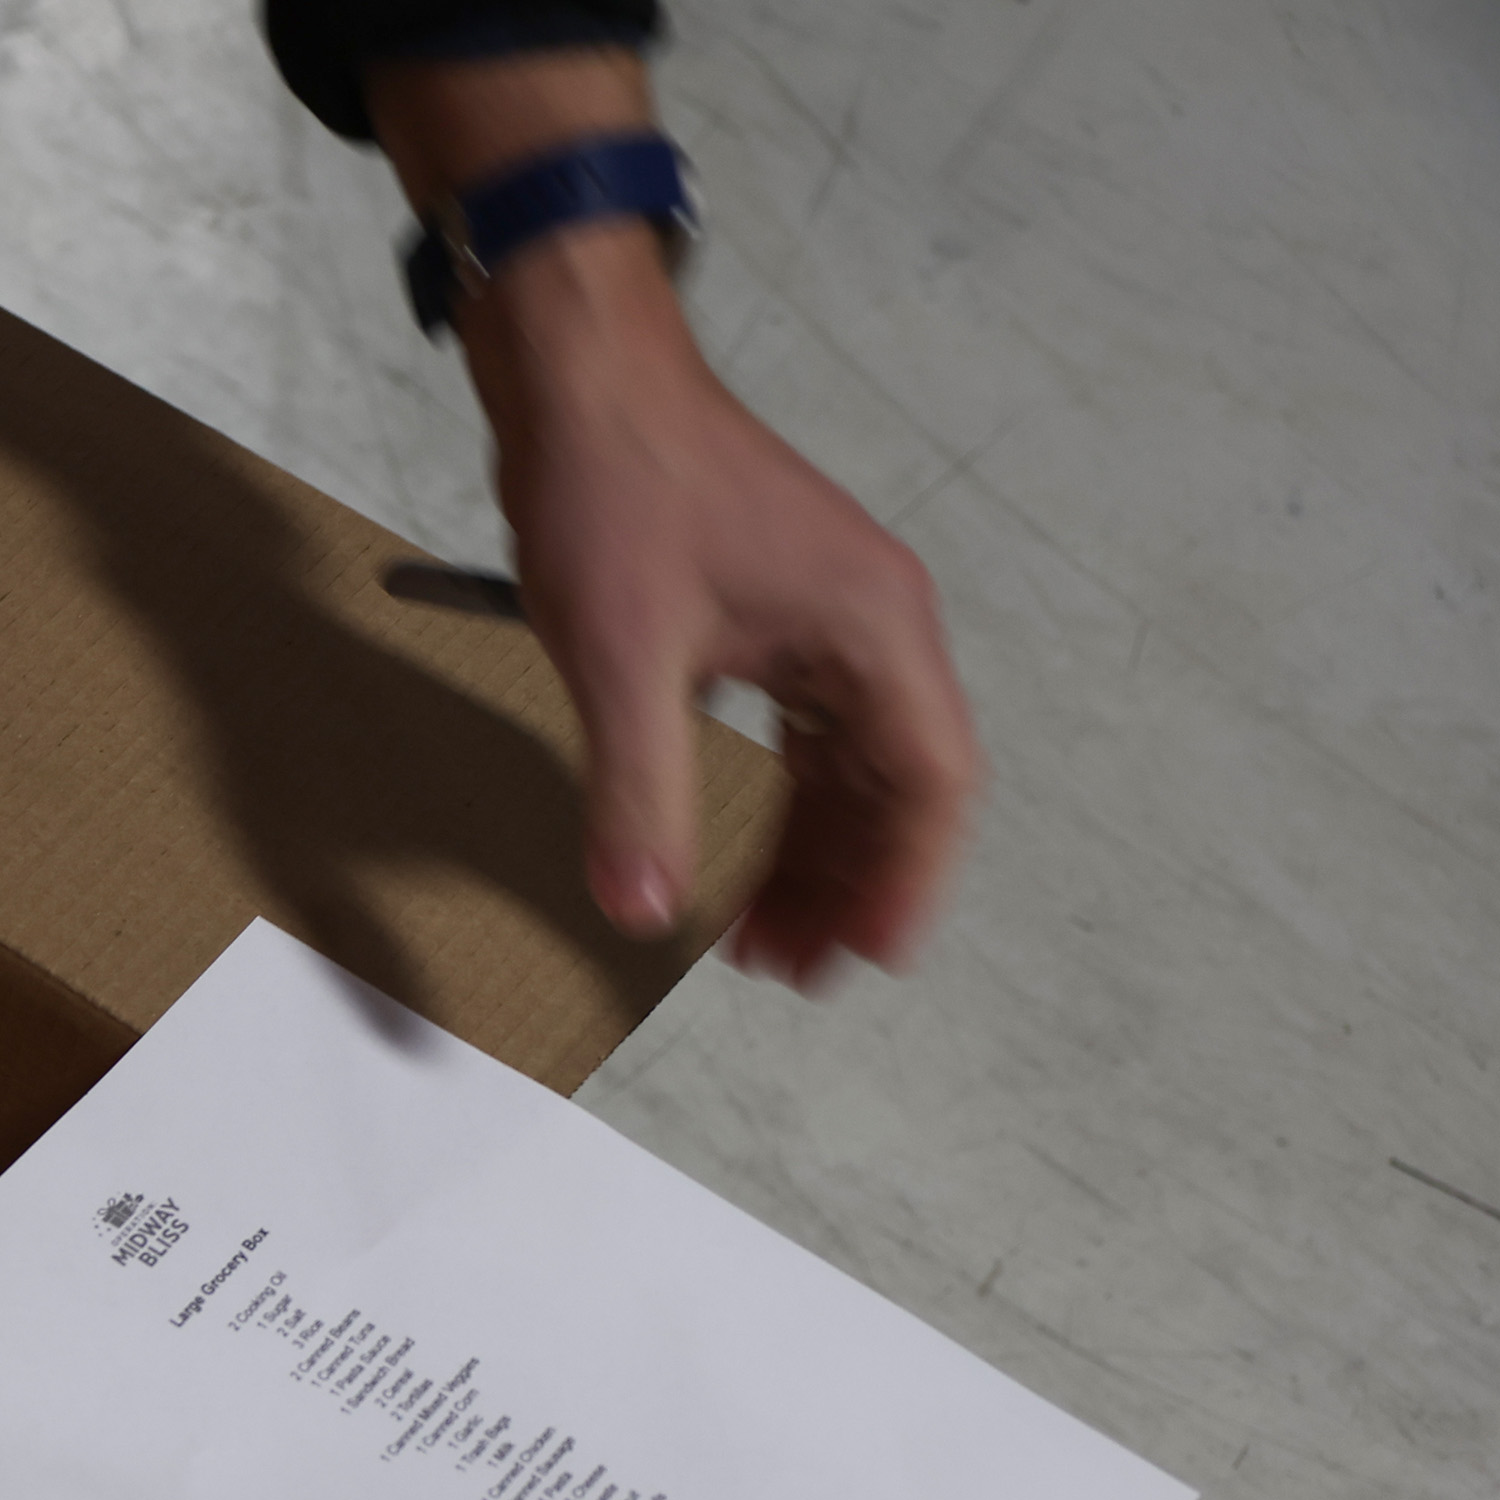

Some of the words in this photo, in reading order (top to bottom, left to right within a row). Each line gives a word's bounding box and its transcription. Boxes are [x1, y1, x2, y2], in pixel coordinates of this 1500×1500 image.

[110, 1196, 181, 1268] MIDWAY
[137, 1217, 190, 1269] BLISS
[168, 1295, 206, 1329] Large
[199, 1249, 249, 1297] Grocery
[240, 1227, 270, 1252] Box
[227, 1321, 241, 1332] 2
[235, 1285, 277, 1324] Cooking
[269, 1270, 288, 1287] Oil
[256, 1321, 267, 1329] 1
[262, 1293, 293, 1323] Sugar
[276, 1326, 290, 1338] 2
[283, 1308, 307, 1330] Salt
[298, 1319, 325, 1342] Rice
[289, 1370, 303, 1382] 2
[297, 1336, 335, 1374] Canned
[328, 1308, 362, 1340] Beans
[310, 1379, 321, 1387] 1
[316, 1344, 355, 1382] Canned
[347, 1321, 376, 1346] Tuna
[359, 1334, 392, 1365] Sauce
[384, 1336, 416, 1367] Bread
[329, 1388, 340, 1396] 1
[334, 1363, 366, 1391] Pasta
[345, 1365, 391, 1409] Sandwich
[374, 1397, 388, 1409] 2
[381, 1367, 415, 1400] Cereal
[340, 1406, 351, 1414] 1
[380, 1454, 390, 1462] 1
[386, 1418, 424, 1456] Canned
[416, 1388, 449, 1422] Mixed
[441, 1356, 481, 1393] Veggies
[389, 1410, 404, 1422] 2
[415, 1445, 426, 1454] 1
[421, 1409, 460, 1447] Canned
[453, 1388, 480, 1412] Corn
[447, 1441, 458, 1449] 1
[453, 1414, 484, 1443] Garlic
[483, 1414, 512, 1440] Bags
[455, 1463, 466, 1471] 1
[460, 1438, 490, 1464] Trash
[487, 1461, 525, 1499] Canned
[543, 1471, 574, 1499] Pasta
